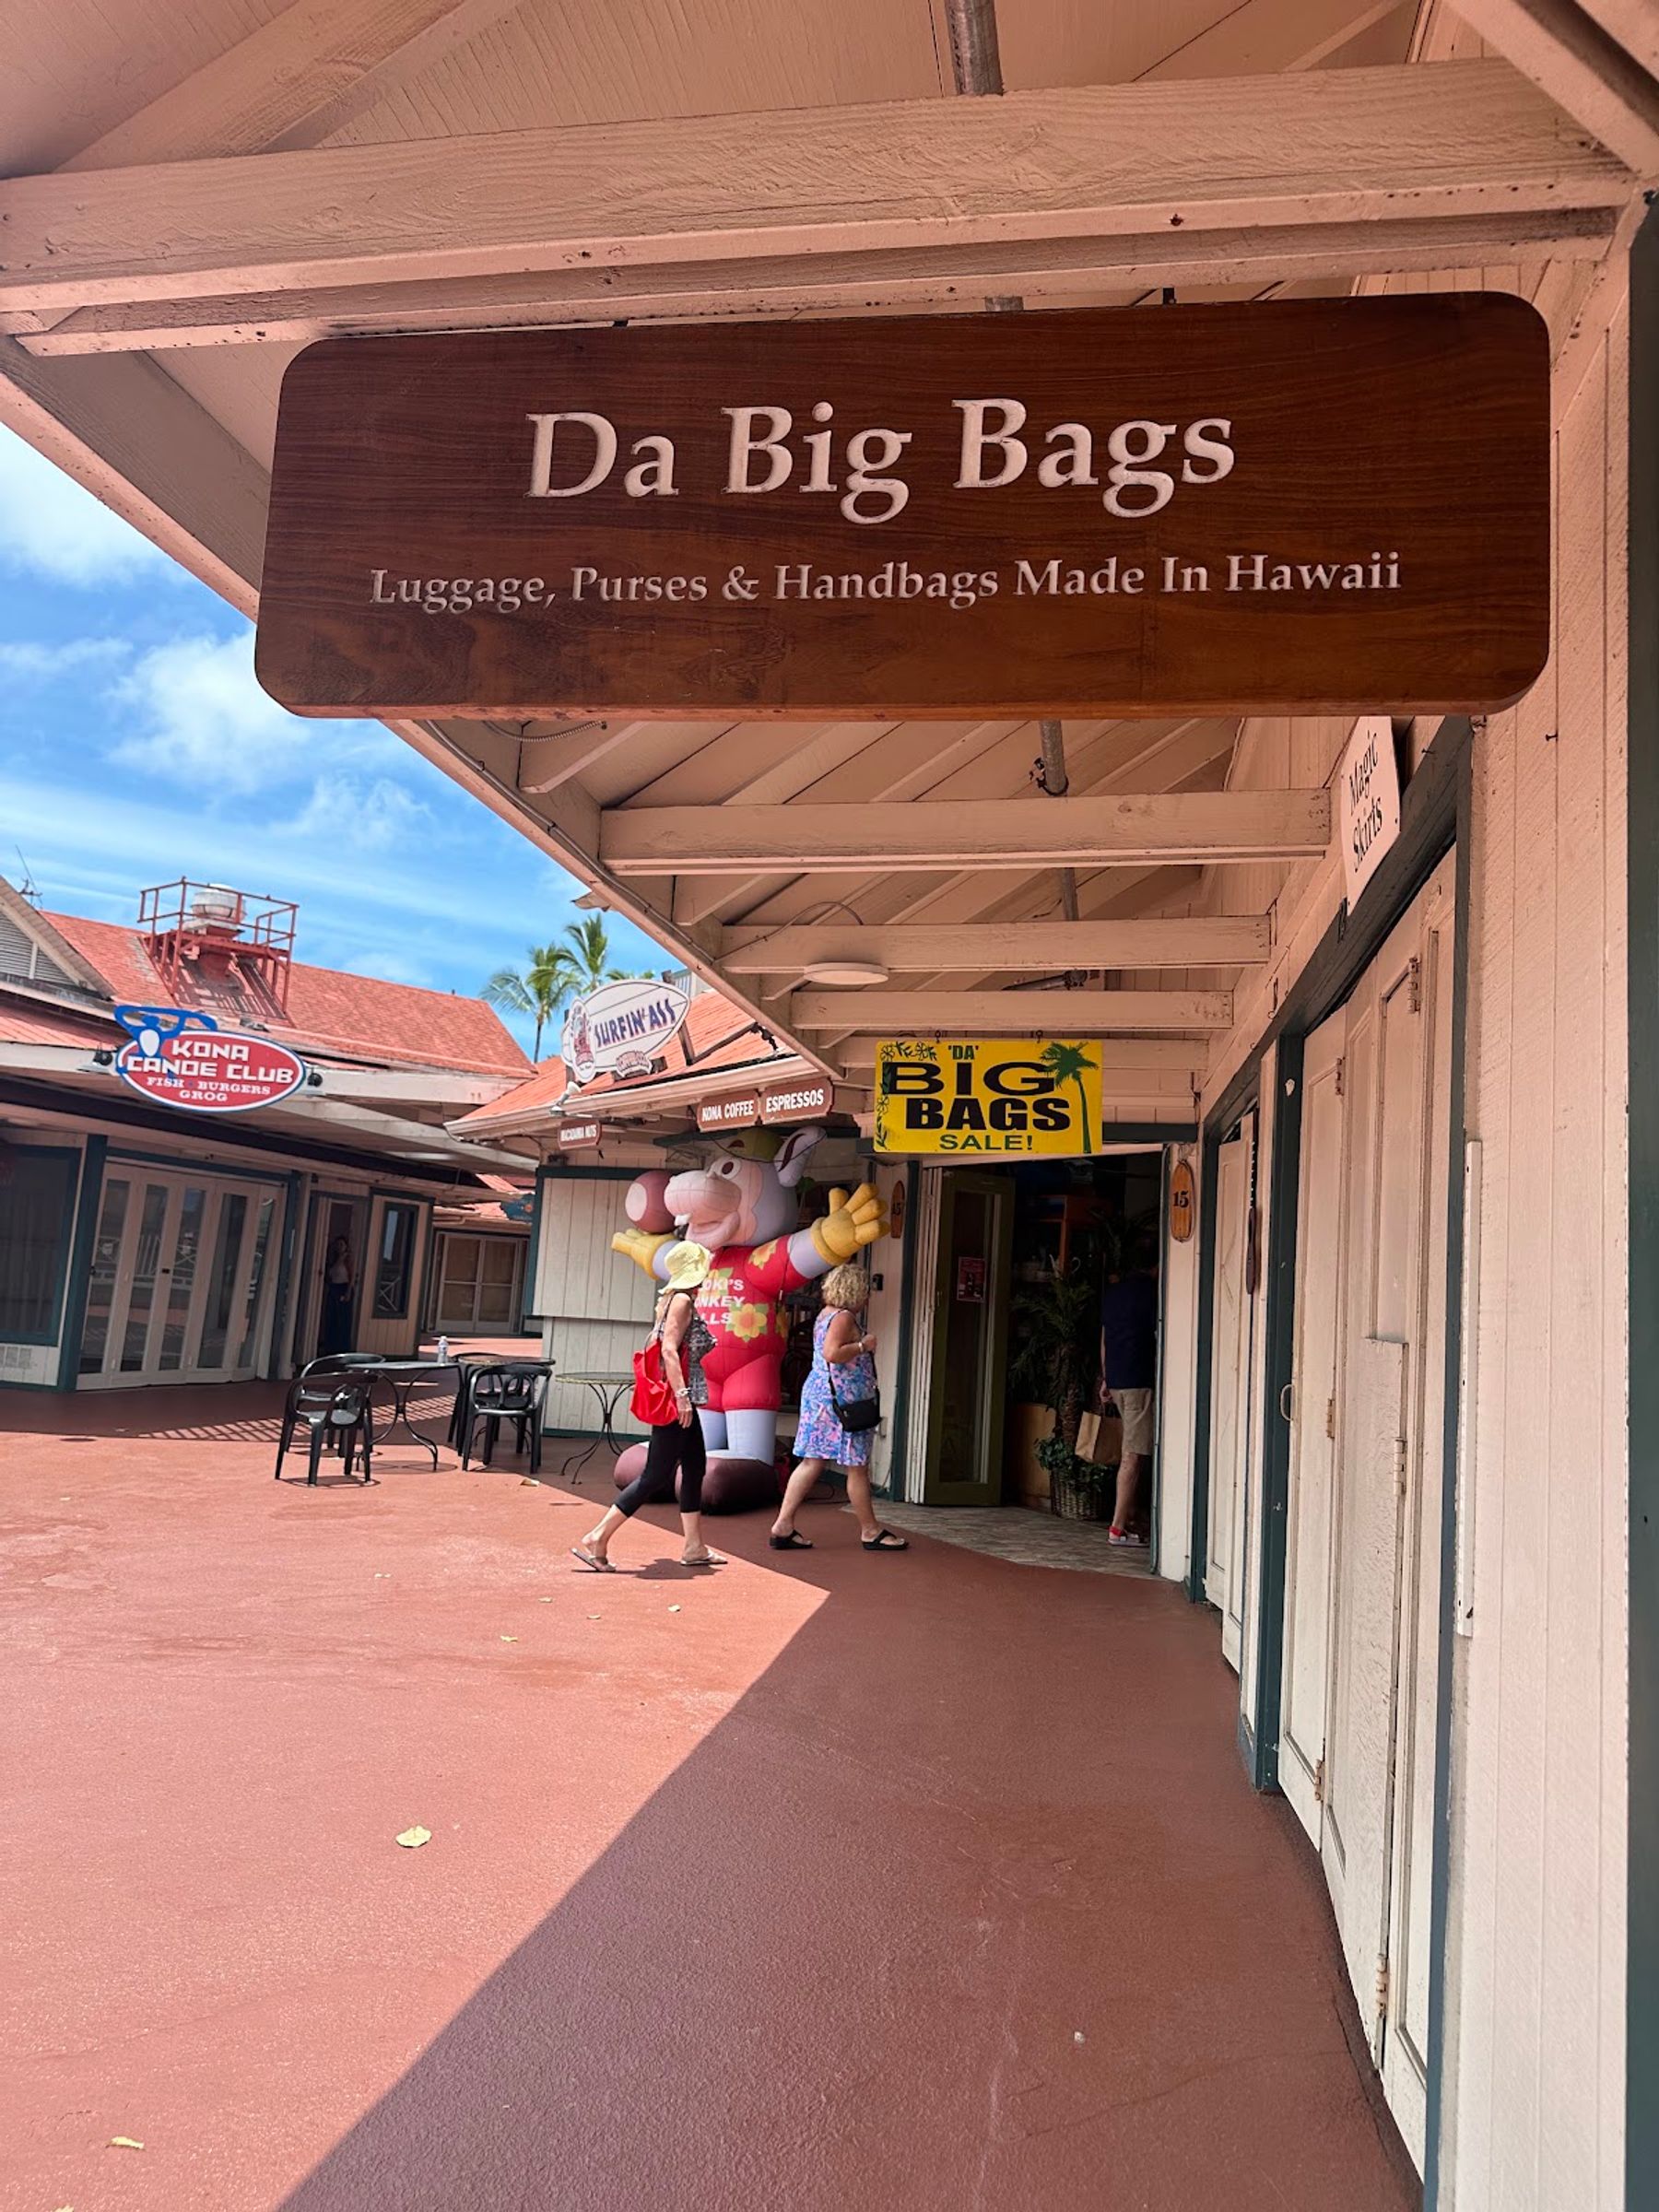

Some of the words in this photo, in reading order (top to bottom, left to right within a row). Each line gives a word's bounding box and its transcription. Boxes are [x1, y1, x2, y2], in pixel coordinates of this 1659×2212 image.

[524, 411, 679, 498] Da
[721, 401, 912, 524] Big
[951, 397, 1235, 518] Bags
[370, 569, 556, 614] Luggage,
[570, 565, 708, 601] Purses
[721, 565, 759, 600] &
[773, 561, 998, 609] Handbags
[1013, 557, 1145, 596] Made
[1160, 556, 1210, 592] In
[1226, 551, 1402, 590] Hawaii
[1349, 729, 1380, 817] Magic
[1352, 796, 1383, 872] Skirts
[171, 1039, 250, 1062] KONA
[126, 1055, 218, 1077] CANOE
[226, 1064, 295, 1085] CLUB
[881, 1061, 1055, 1097] BIG
[146, 1077, 185, 1089] FISH
[196, 1080, 271, 1095] BURGERS
[179, 1088, 229, 1102] GROG
[724, 1099, 755, 1119] COFFEE
[765, 1088, 824, 1113] ESPRESSOS
[905, 1097, 1071, 1132] BAGS
[939, 1134, 1033, 1151] SALE!
[1172, 1190, 1189, 1208] 15
